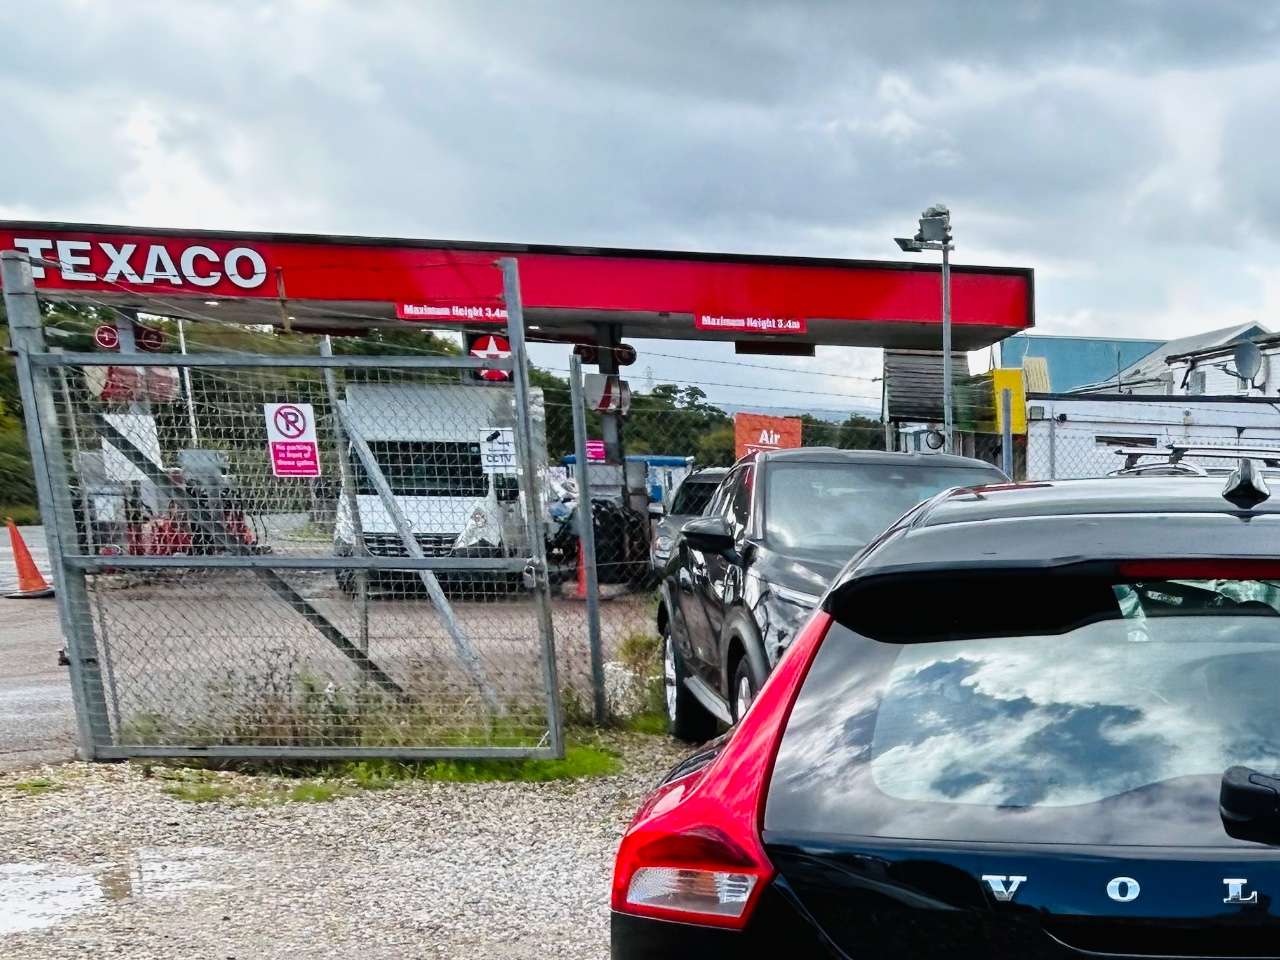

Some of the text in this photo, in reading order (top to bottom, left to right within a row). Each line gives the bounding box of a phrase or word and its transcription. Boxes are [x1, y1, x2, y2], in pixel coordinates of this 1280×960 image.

[13, 237, 267, 289] TEXACO
[452, 305, 483, 318] Height
[746, 317, 776, 329] Height
[759, 429, 781, 445] Air
[486, 454, 512, 463] CCTV
